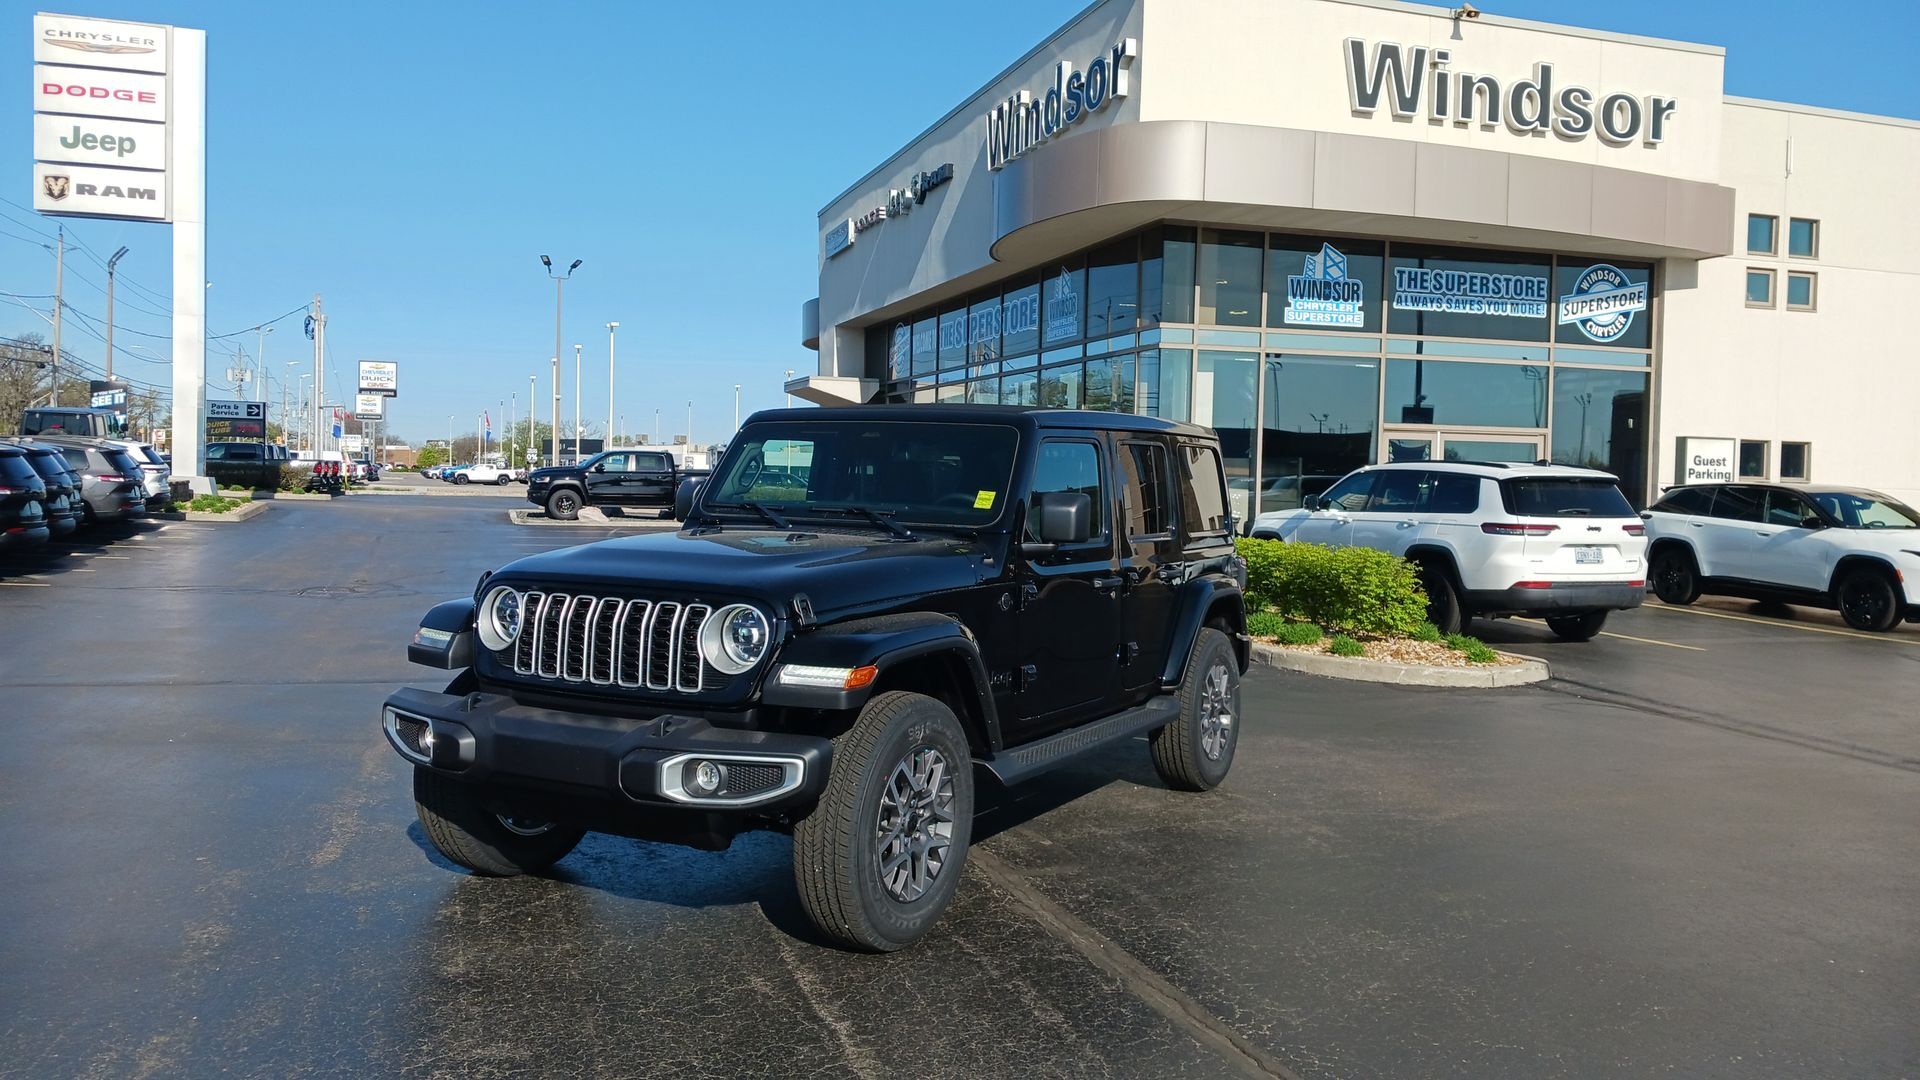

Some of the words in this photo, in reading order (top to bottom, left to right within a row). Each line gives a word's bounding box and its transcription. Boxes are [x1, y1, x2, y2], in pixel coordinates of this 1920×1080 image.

[45, 29, 155, 46] CHRYSLER
[43, 83, 156, 104] DODGE
[1343, 37, 1677, 144] Windsor
[986, 38, 1136, 171] Windsor
[60, 126, 136, 157] Jeep
[76, 184, 156, 200] RAM
[1290, 279, 1360, 302] WINDSOR
[1396, 269, 1429, 291] THE
[1432, 271, 1546, 298] SUPERSTORE
[1580, 270, 1620, 290] WINDSOR
[1296, 301, 1353, 312] CHRYSLER
[1396, 294, 1442, 309] ALWAYS
[1446, 296, 1483, 312] SAVES
[1486, 299, 1508, 313] YOU
[1510, 301, 1545, 315] MORE!
[1564, 291, 1643, 316] SUPERSTORE
[940, 322, 954, 350] THE
[955, 294, 1039, 348] SUPERSTORE
[1288, 311, 1361, 322] SUPERSTORE
[1586, 314, 1627, 337] CHRYSLER
[91, 395, 112, 408] SEE
[114, 392, 126, 404] IT
[526, 453, 538, 461] 0%
[1693, 455, 1727, 466] Guest
[1688, 468, 1732, 482] Parking
